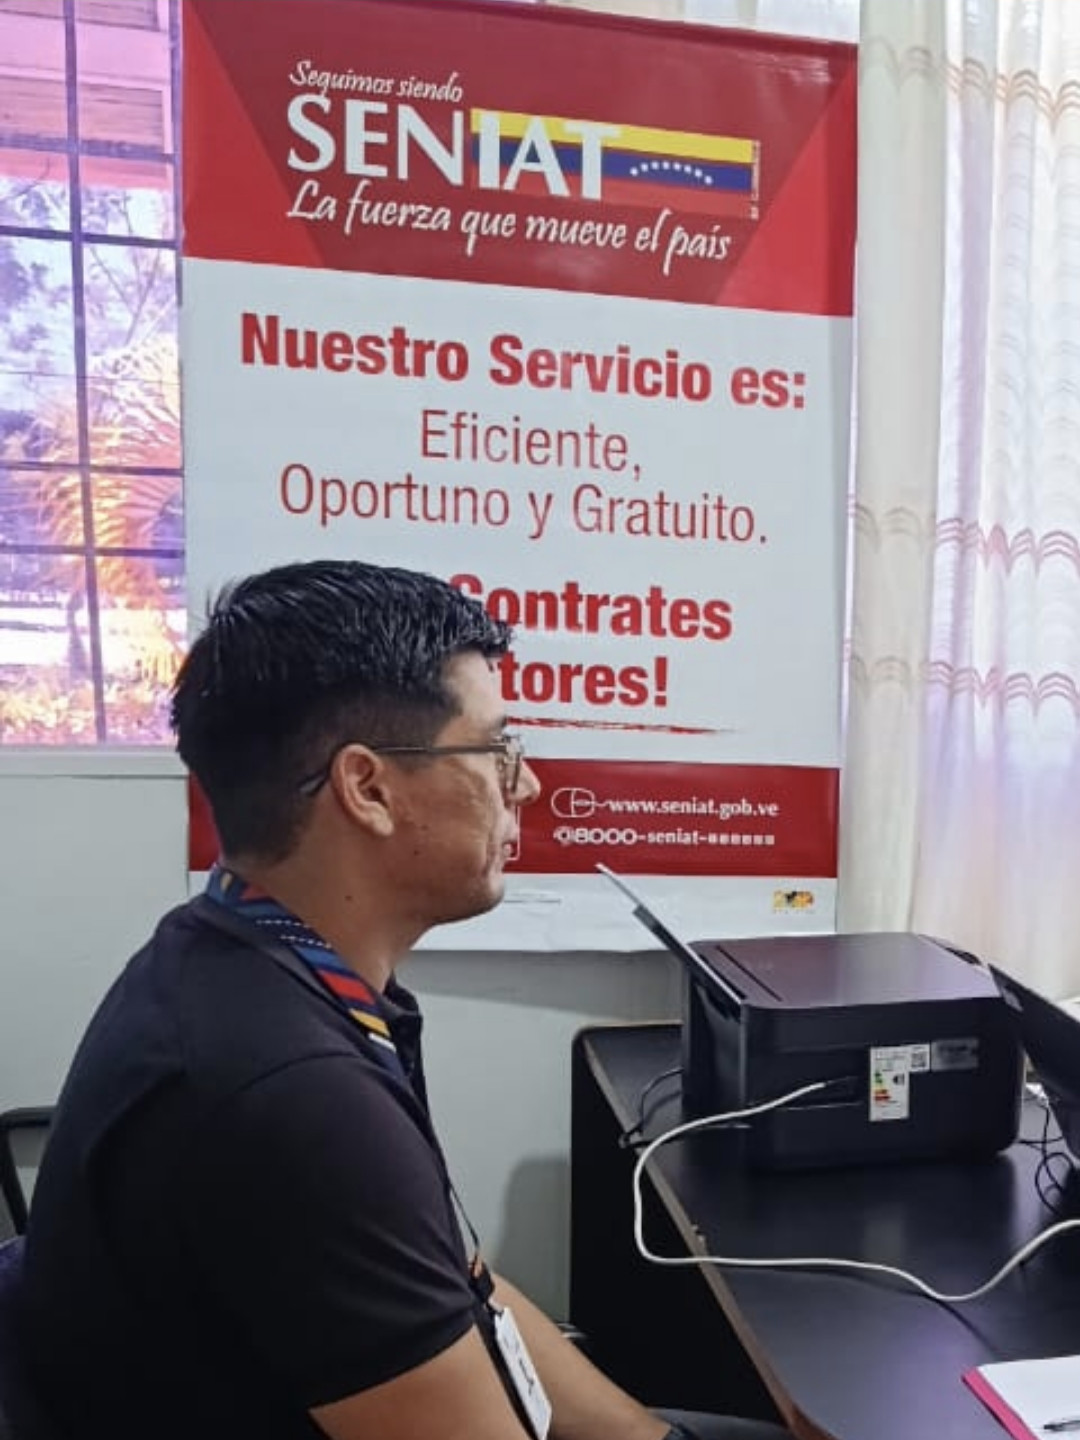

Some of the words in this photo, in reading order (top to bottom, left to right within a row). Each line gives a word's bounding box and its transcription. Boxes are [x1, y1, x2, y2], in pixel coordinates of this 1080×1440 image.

[289, 60, 394, 97] Seguimos
[398, 72, 463, 103] siendo
[286, 93, 621, 201] SENIAT
[286, 180, 336, 221] La
[344, 179, 450, 234] fuerza
[460, 207, 516, 256] que
[526, 216, 628, 250] mueve
[634, 209, 672, 253] el
[666, 222, 731, 276] país
[241, 312, 469, 382] Nuestro
[489, 333, 712, 403] Servicio
[730, 368, 806, 409] es:
[420, 409, 642, 480] Eficiente,
[280, 463, 510, 527] Oportuno
[527, 489, 553, 540] y
[572, 484, 768, 544] Gratuito.
[498, 651, 668, 707] tores!
[608, 796, 779, 820] www.seniat.gob.ve
